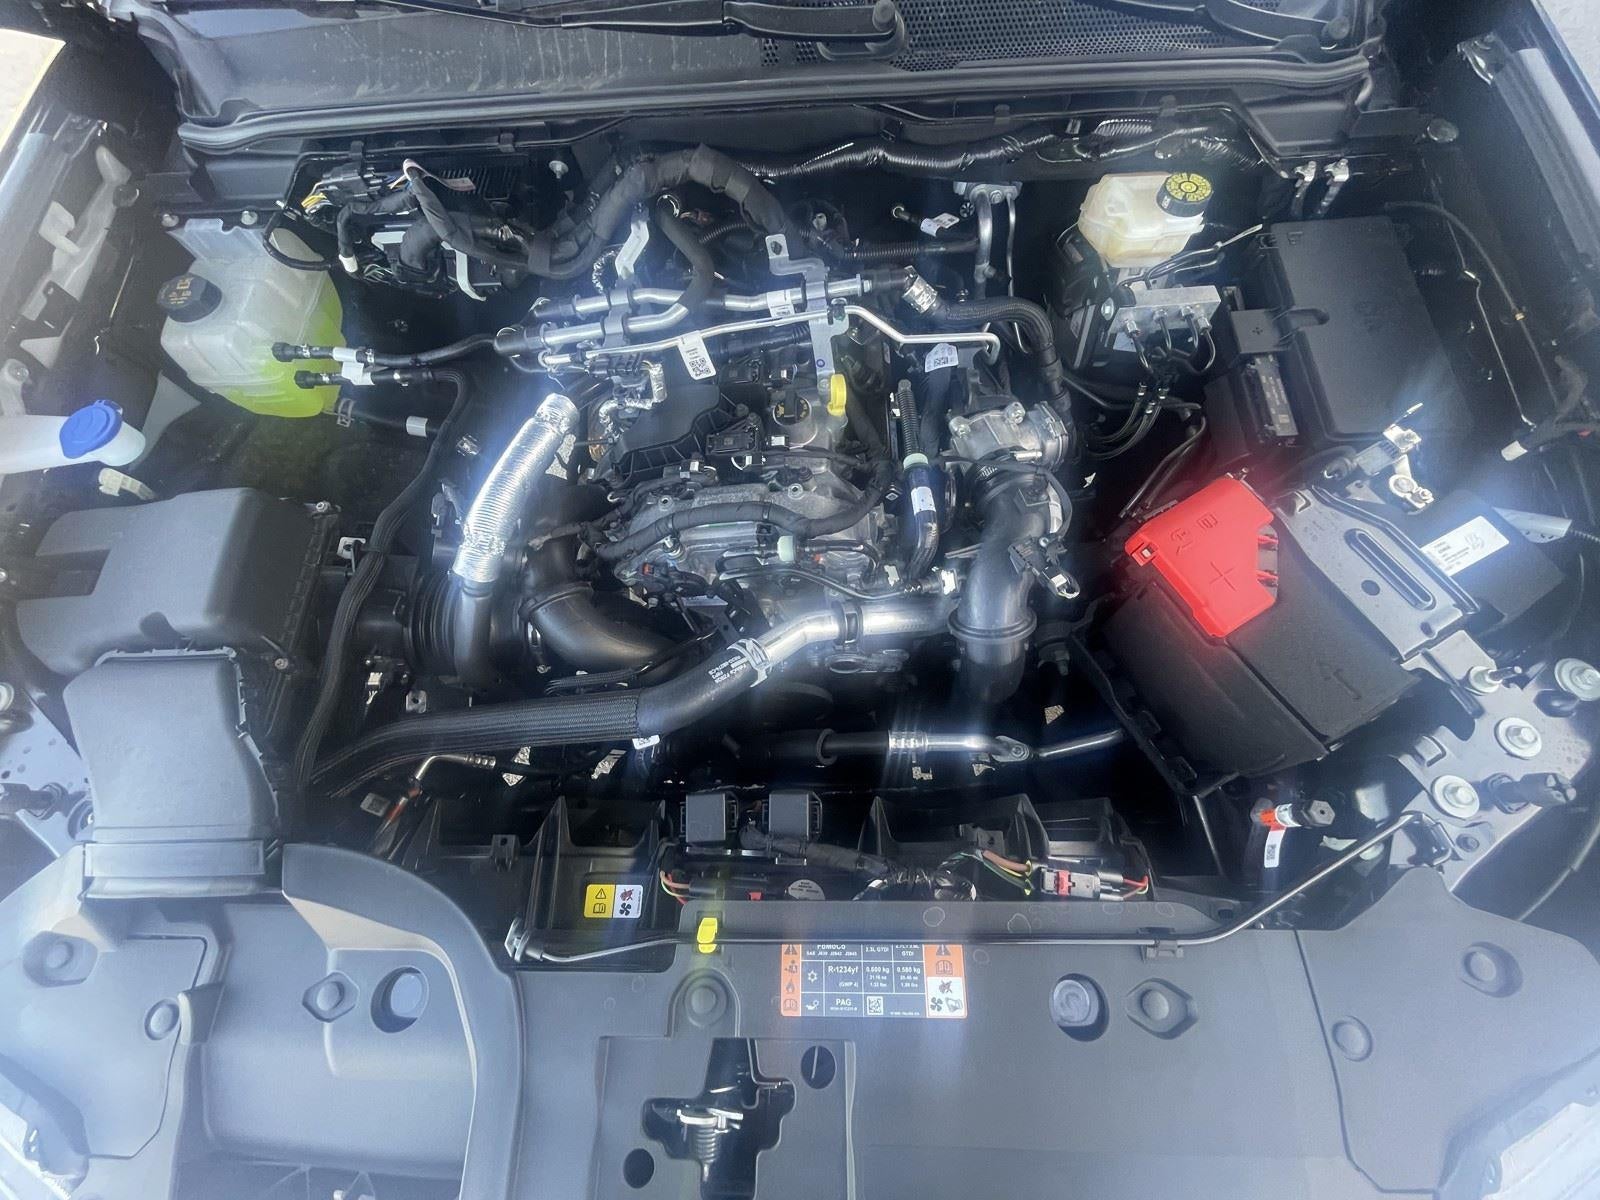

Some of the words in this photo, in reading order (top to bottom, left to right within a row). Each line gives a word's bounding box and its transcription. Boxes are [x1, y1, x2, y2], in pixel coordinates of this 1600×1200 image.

[828, 965, 859, 975] R-1234yf
[882, 966, 890, 975] kg
[913, 966, 921, 975] kg
[835, 998, 852, 1006] PAG
